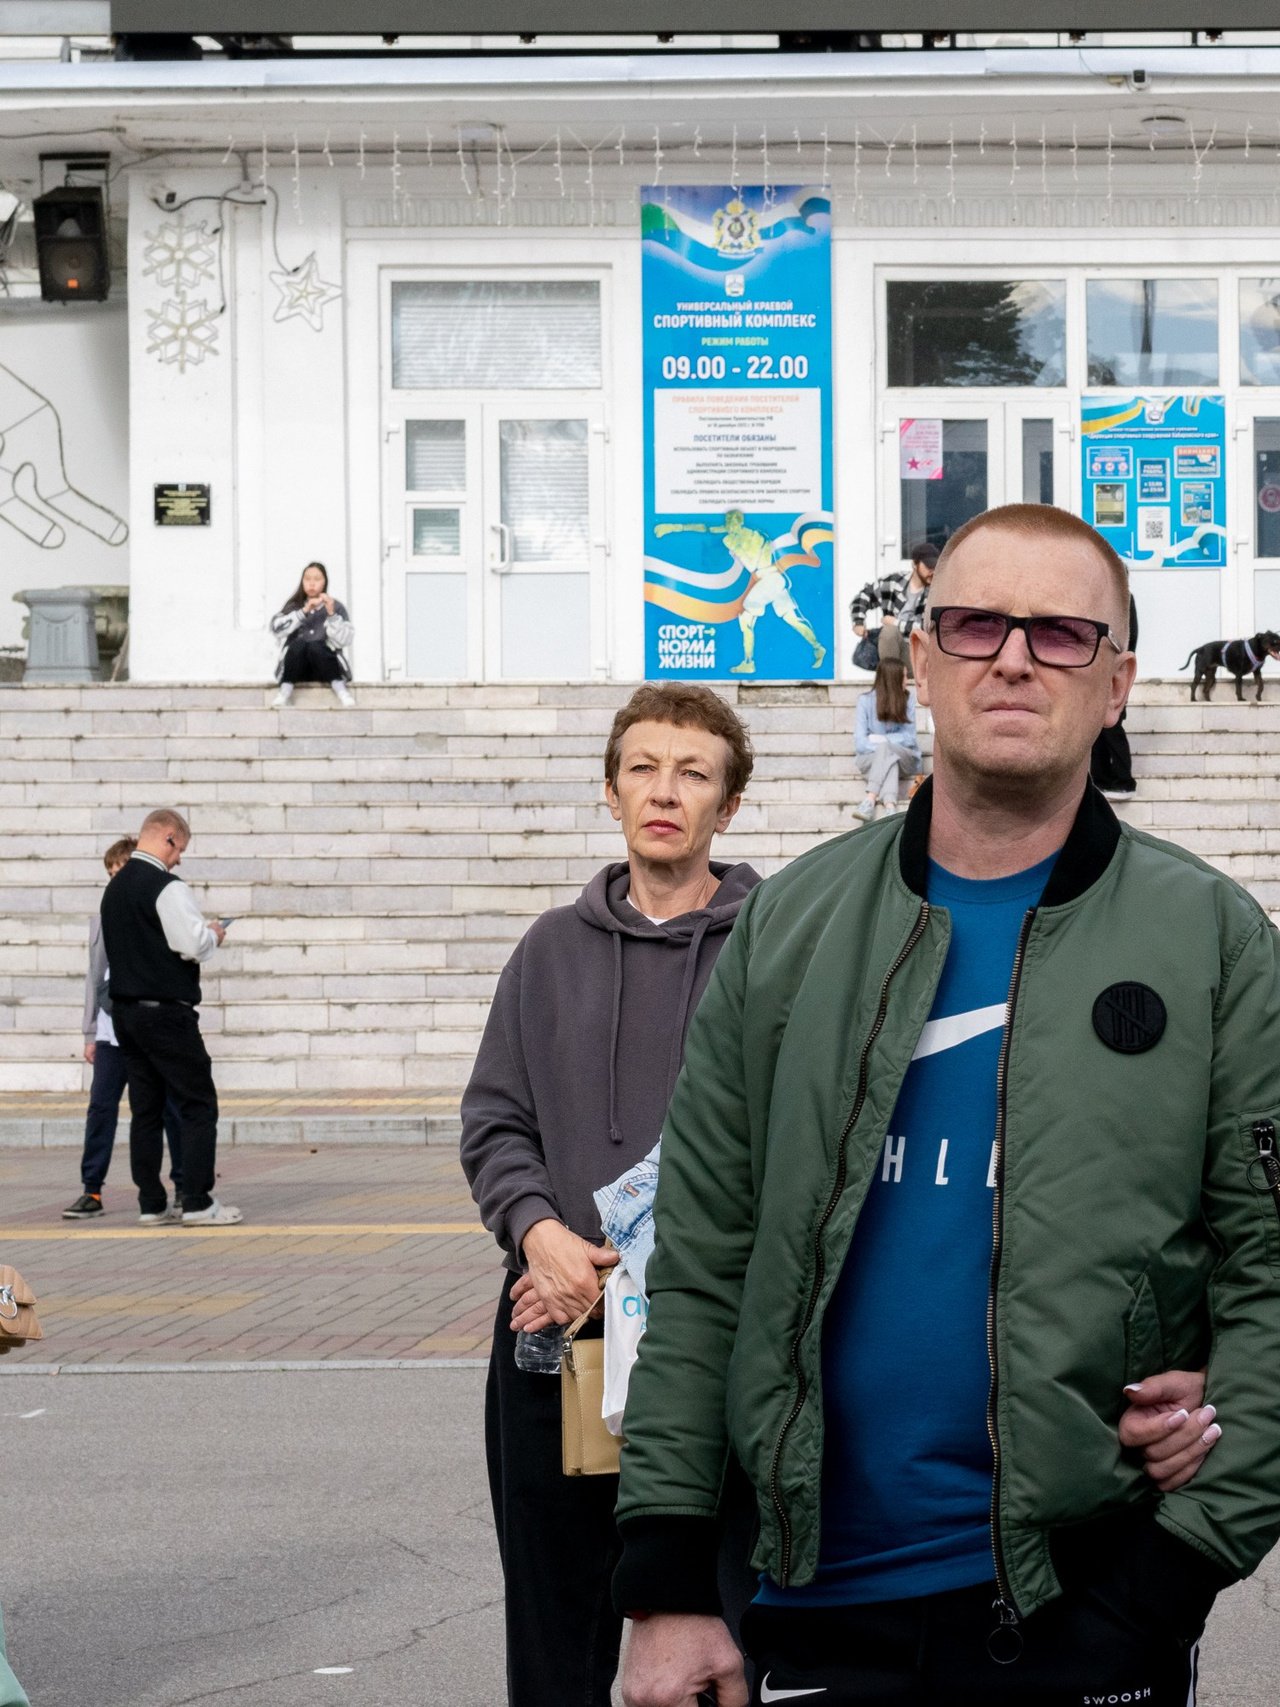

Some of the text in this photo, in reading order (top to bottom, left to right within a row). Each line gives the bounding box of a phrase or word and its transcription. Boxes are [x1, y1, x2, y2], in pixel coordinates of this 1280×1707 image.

[677, 300, 793, 311] УНИВЕРСАЛЬНЫЙ КРАЕВОЙ
[654, 312, 816, 328] СПОРТИВНЫЙ КОМПЛЕКС
[701, 336, 769, 346] РЕЖИМ РАБОТЫ
[662, 356, 725, 379] 09.00
[747, 355, 808, 379] 22.00
[694, 434, 776, 442] ПОСЕТИТЕЛИ ОБЯЗАНЫ
[658, 625, 705, 639] СПОРТ
[658, 639, 715, 654] НОРМА
[659, 653, 715, 669] ЖИЗНИ
[1083, 1687, 1151, 1705] SWOOSH
